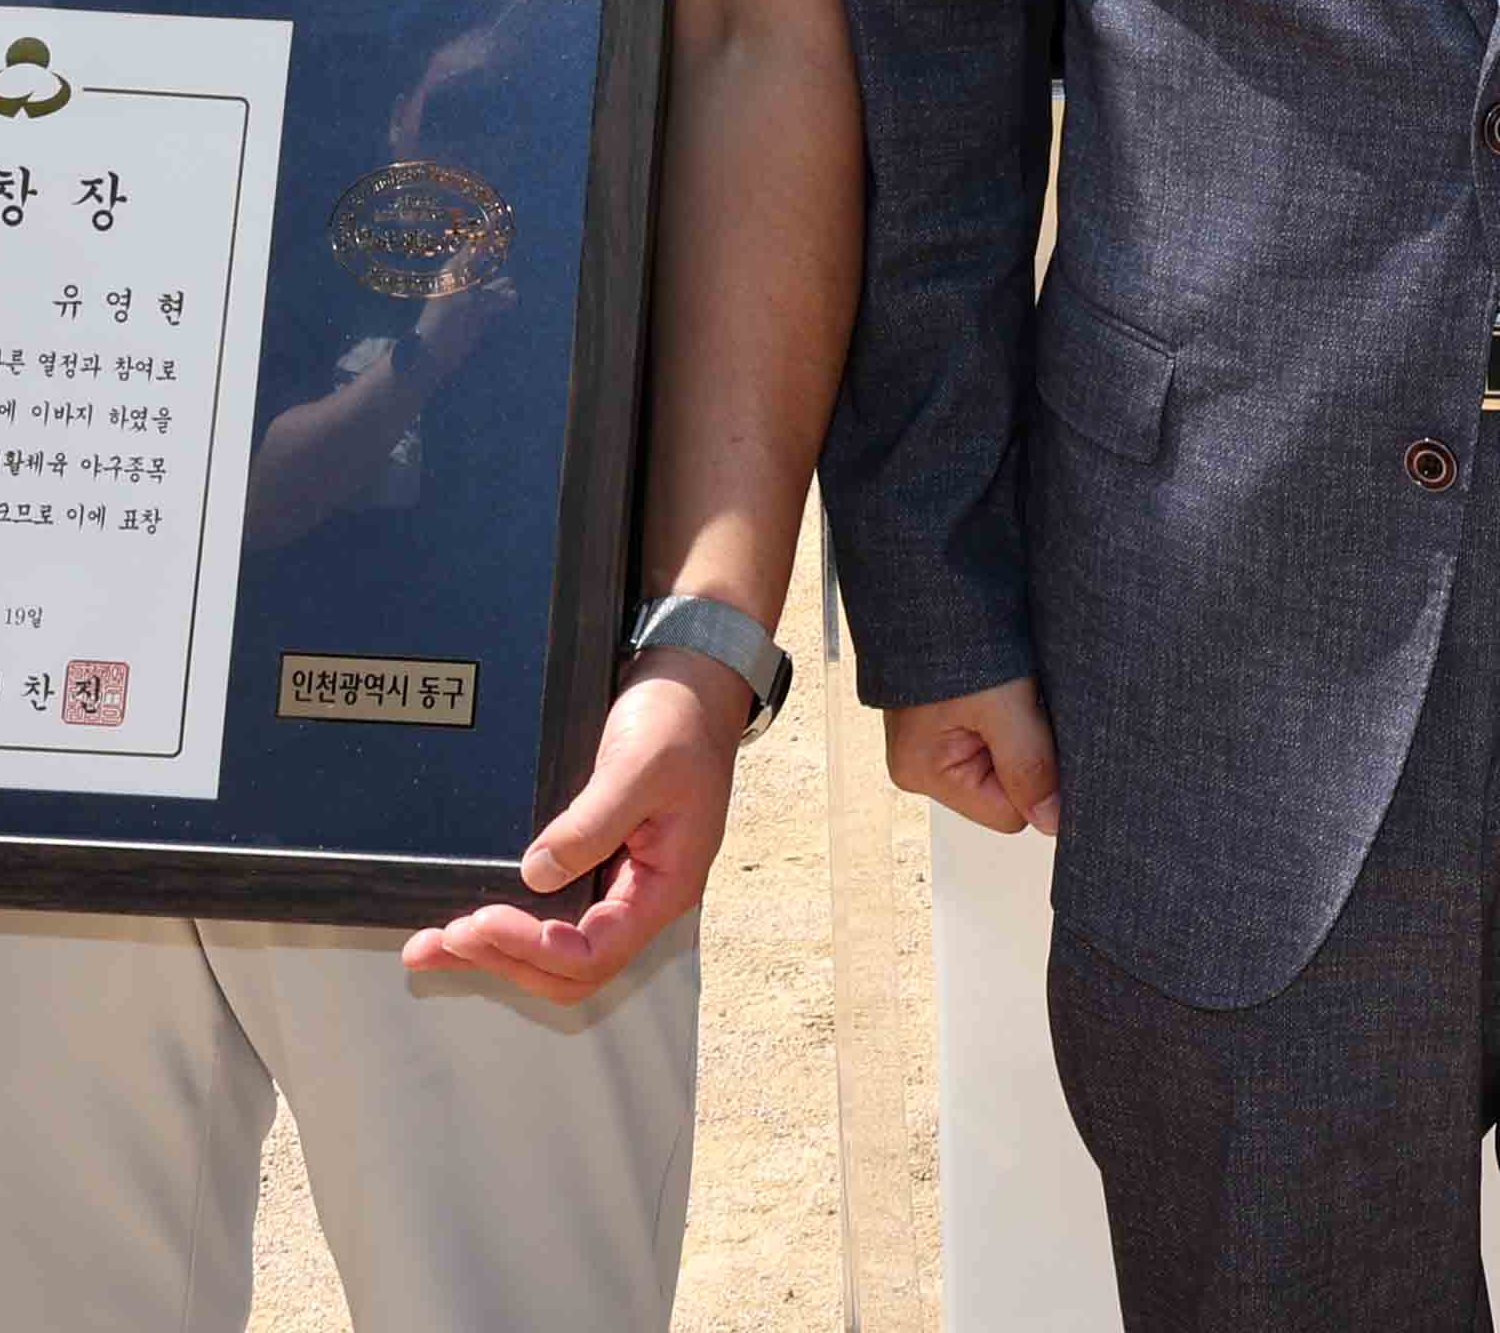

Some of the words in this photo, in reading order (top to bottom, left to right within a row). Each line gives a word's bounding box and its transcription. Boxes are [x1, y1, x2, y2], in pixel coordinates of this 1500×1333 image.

[38, 350, 103, 380] 열정과
[115, 355, 177, 382] 참여로
[31, 400, 93, 428] 이바지
[108, 404, 173, 435] 하였을
[80, 453, 167, 485] 야구종목
[66, 503, 107, 531] 이에
[118, 508, 163, 536] 표창
[4, 606, 43, 630] 19일
[291, 669, 410, 707] 인천광역시
[417, 675, 467, 710] 동구
